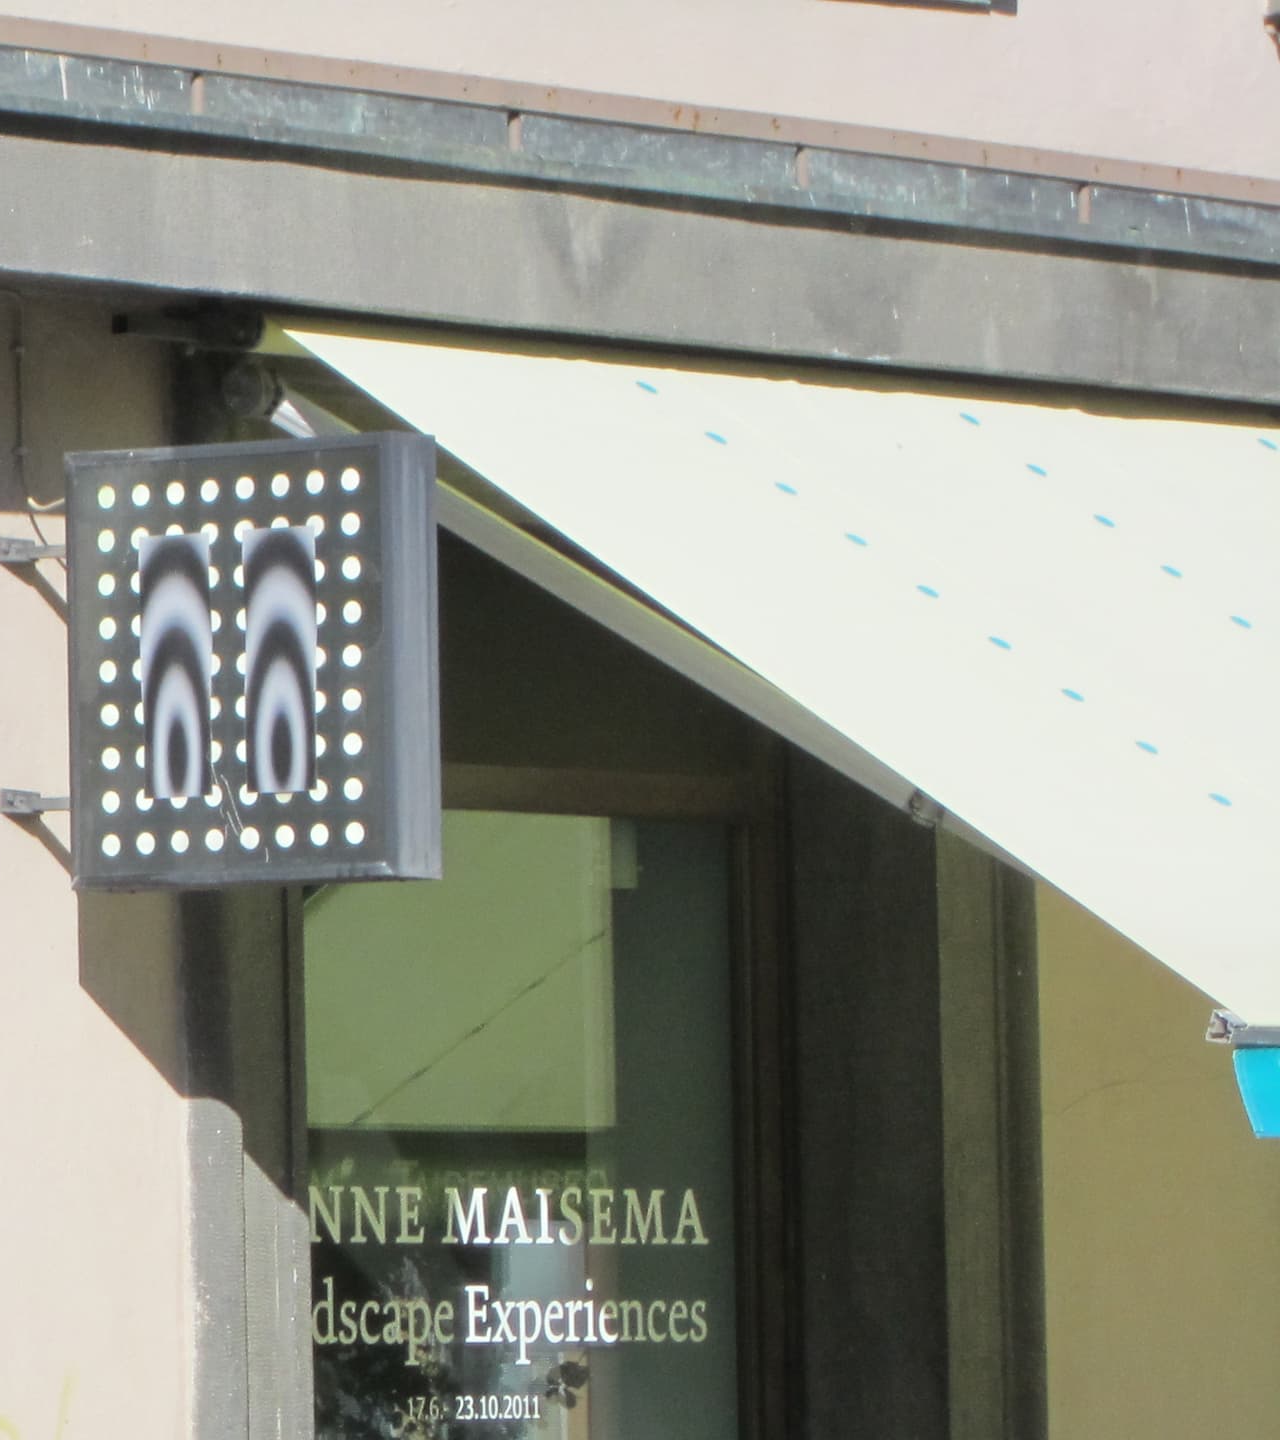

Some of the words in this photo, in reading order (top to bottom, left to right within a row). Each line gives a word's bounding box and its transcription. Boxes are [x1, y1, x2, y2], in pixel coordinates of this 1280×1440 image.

[307, 1185, 425, 1244] NNE
[441, 1186, 710, 1246] MAISEMA
[311, 1276, 455, 1367] dscape
[463, 1278, 709, 1367] Experiences
[455, 1394, 541, 1420] 23.10.2011
